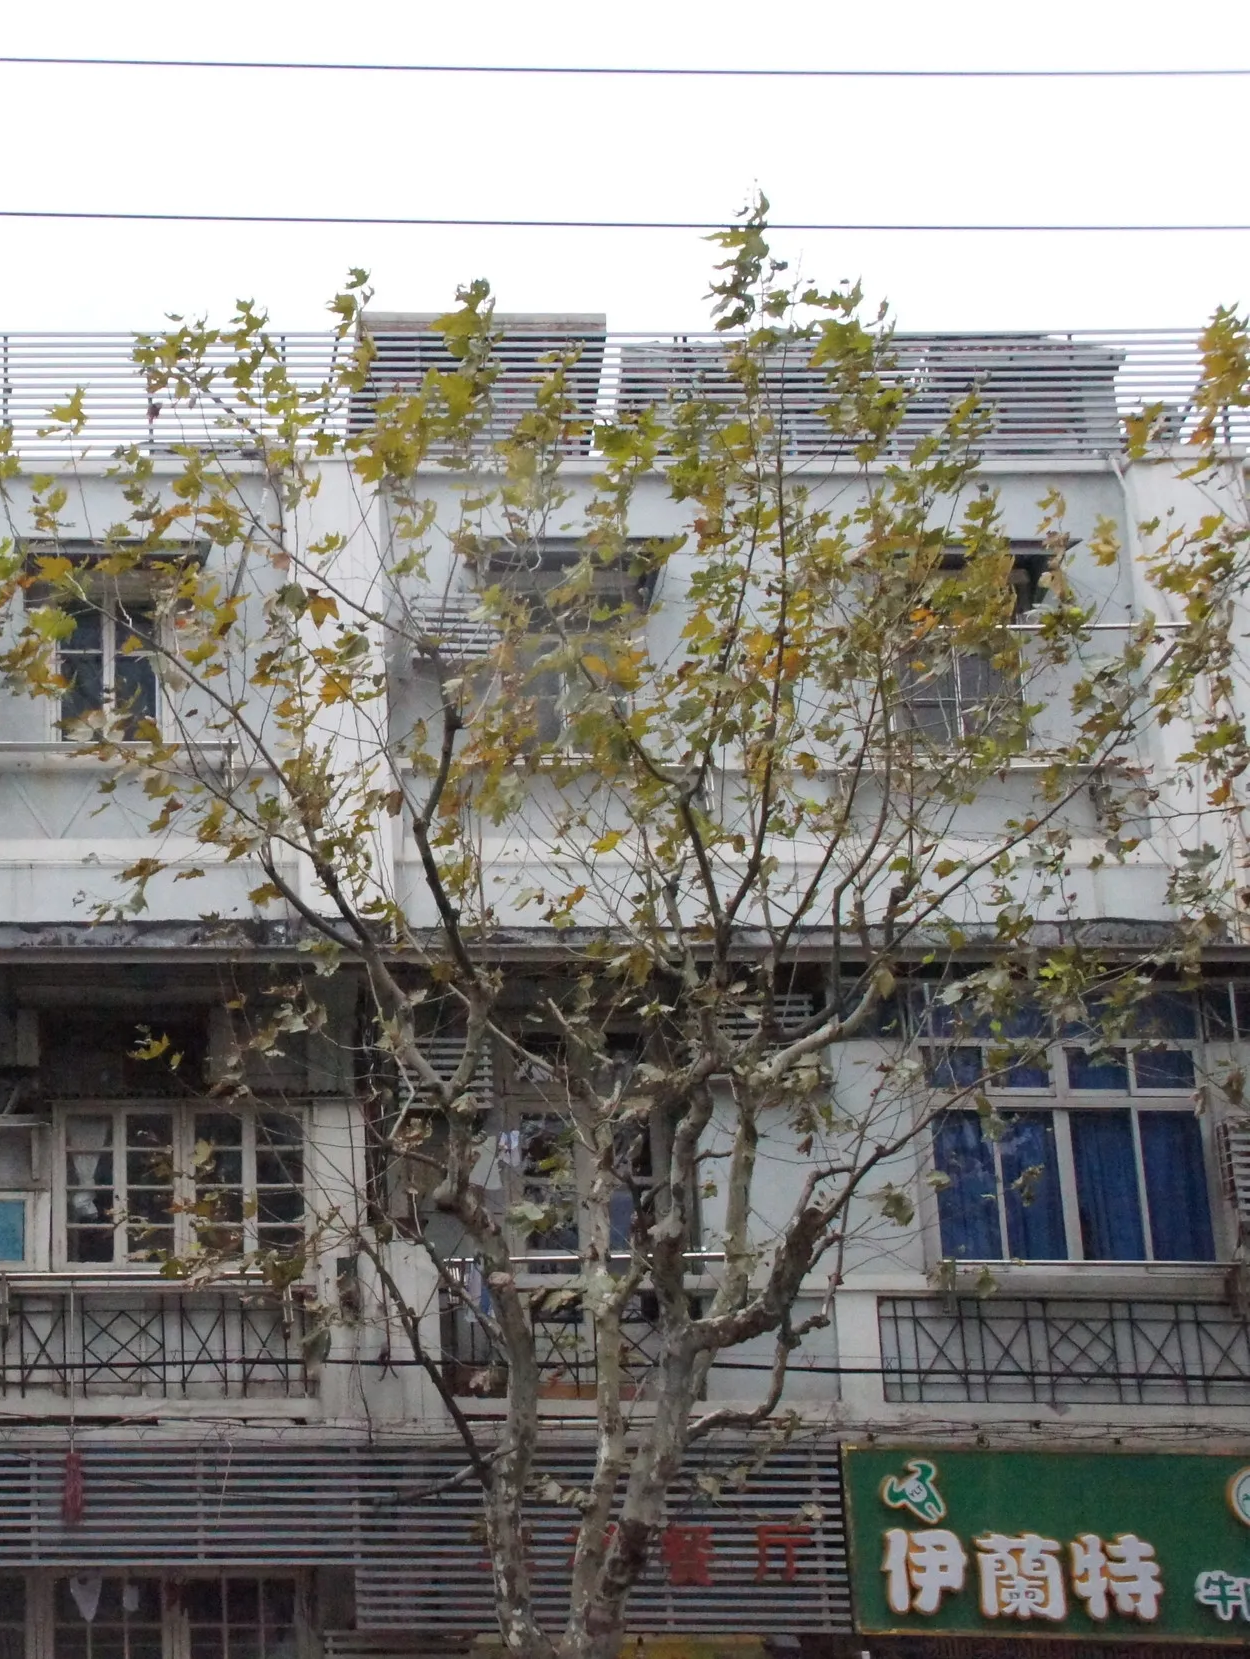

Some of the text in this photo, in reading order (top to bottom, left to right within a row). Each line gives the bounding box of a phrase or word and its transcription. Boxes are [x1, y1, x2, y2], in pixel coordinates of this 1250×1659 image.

[908, 1485, 923, 1497] YLT
[882, 1528, 1164, 1621] 伊蘭特
[1196, 1570, 1250, 1621] 牛
